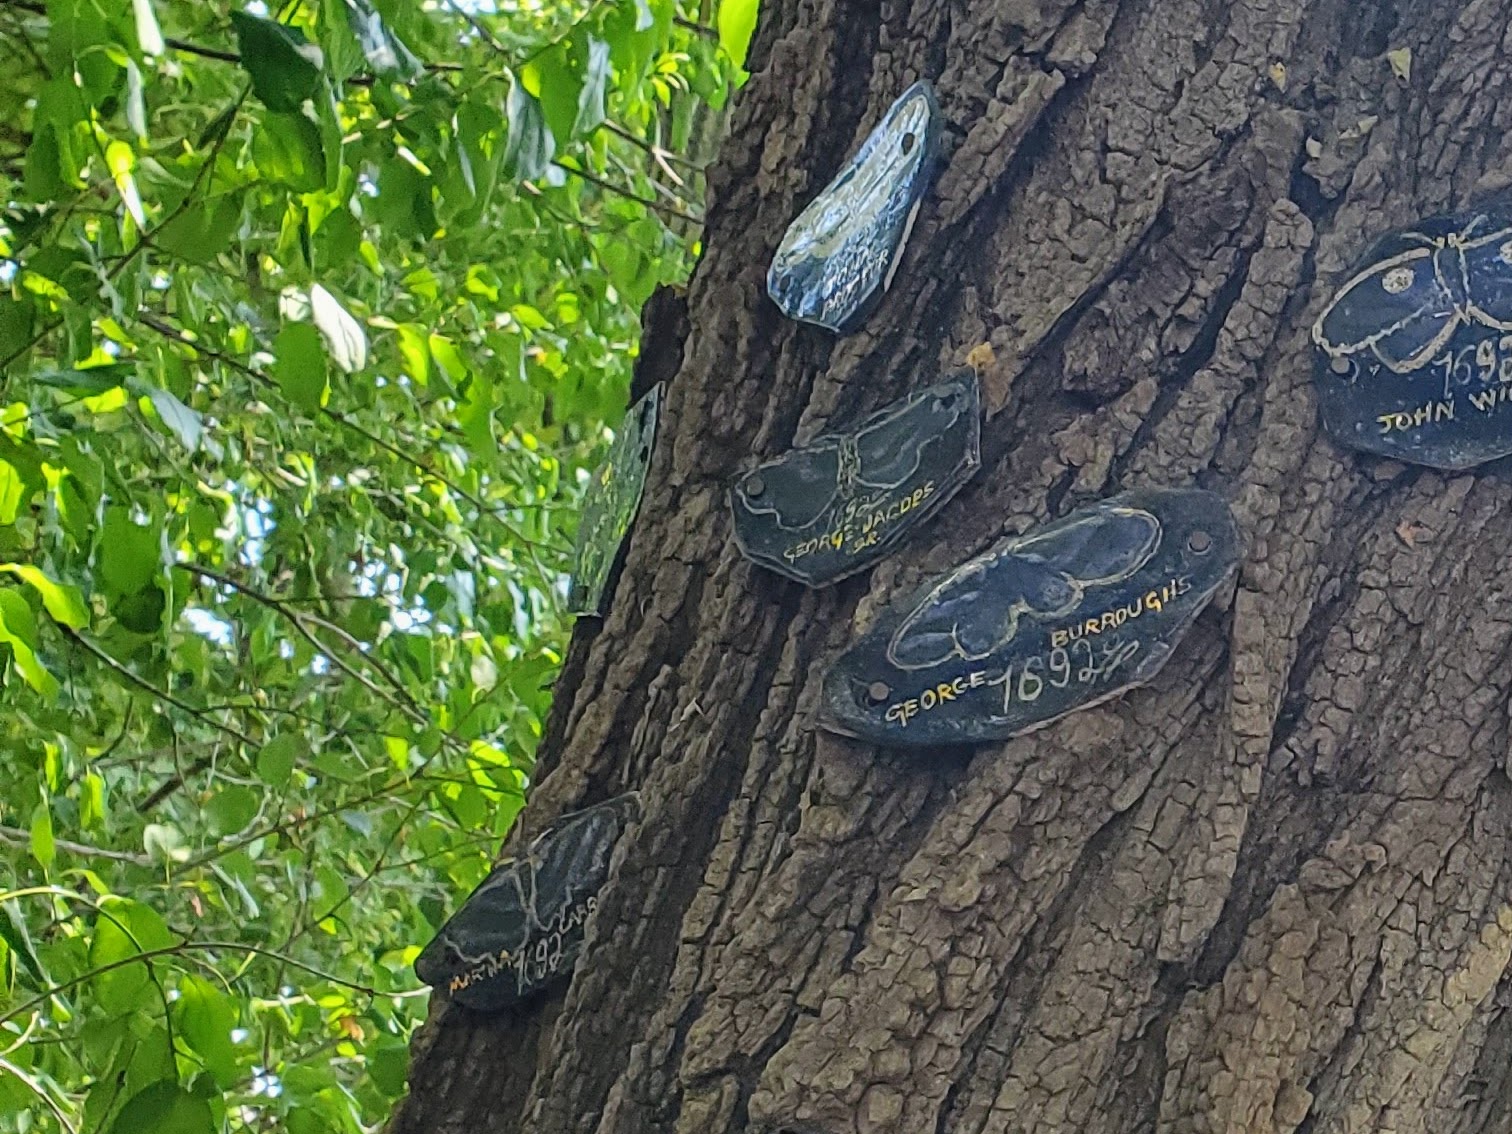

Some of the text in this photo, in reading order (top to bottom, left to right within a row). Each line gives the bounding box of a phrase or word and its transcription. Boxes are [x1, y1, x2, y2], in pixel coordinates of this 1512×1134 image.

[1376, 401, 1455, 434] JOHN
[1052, 574, 1192, 648] BURROUGHS
[885, 669, 987, 728] GEORGE
